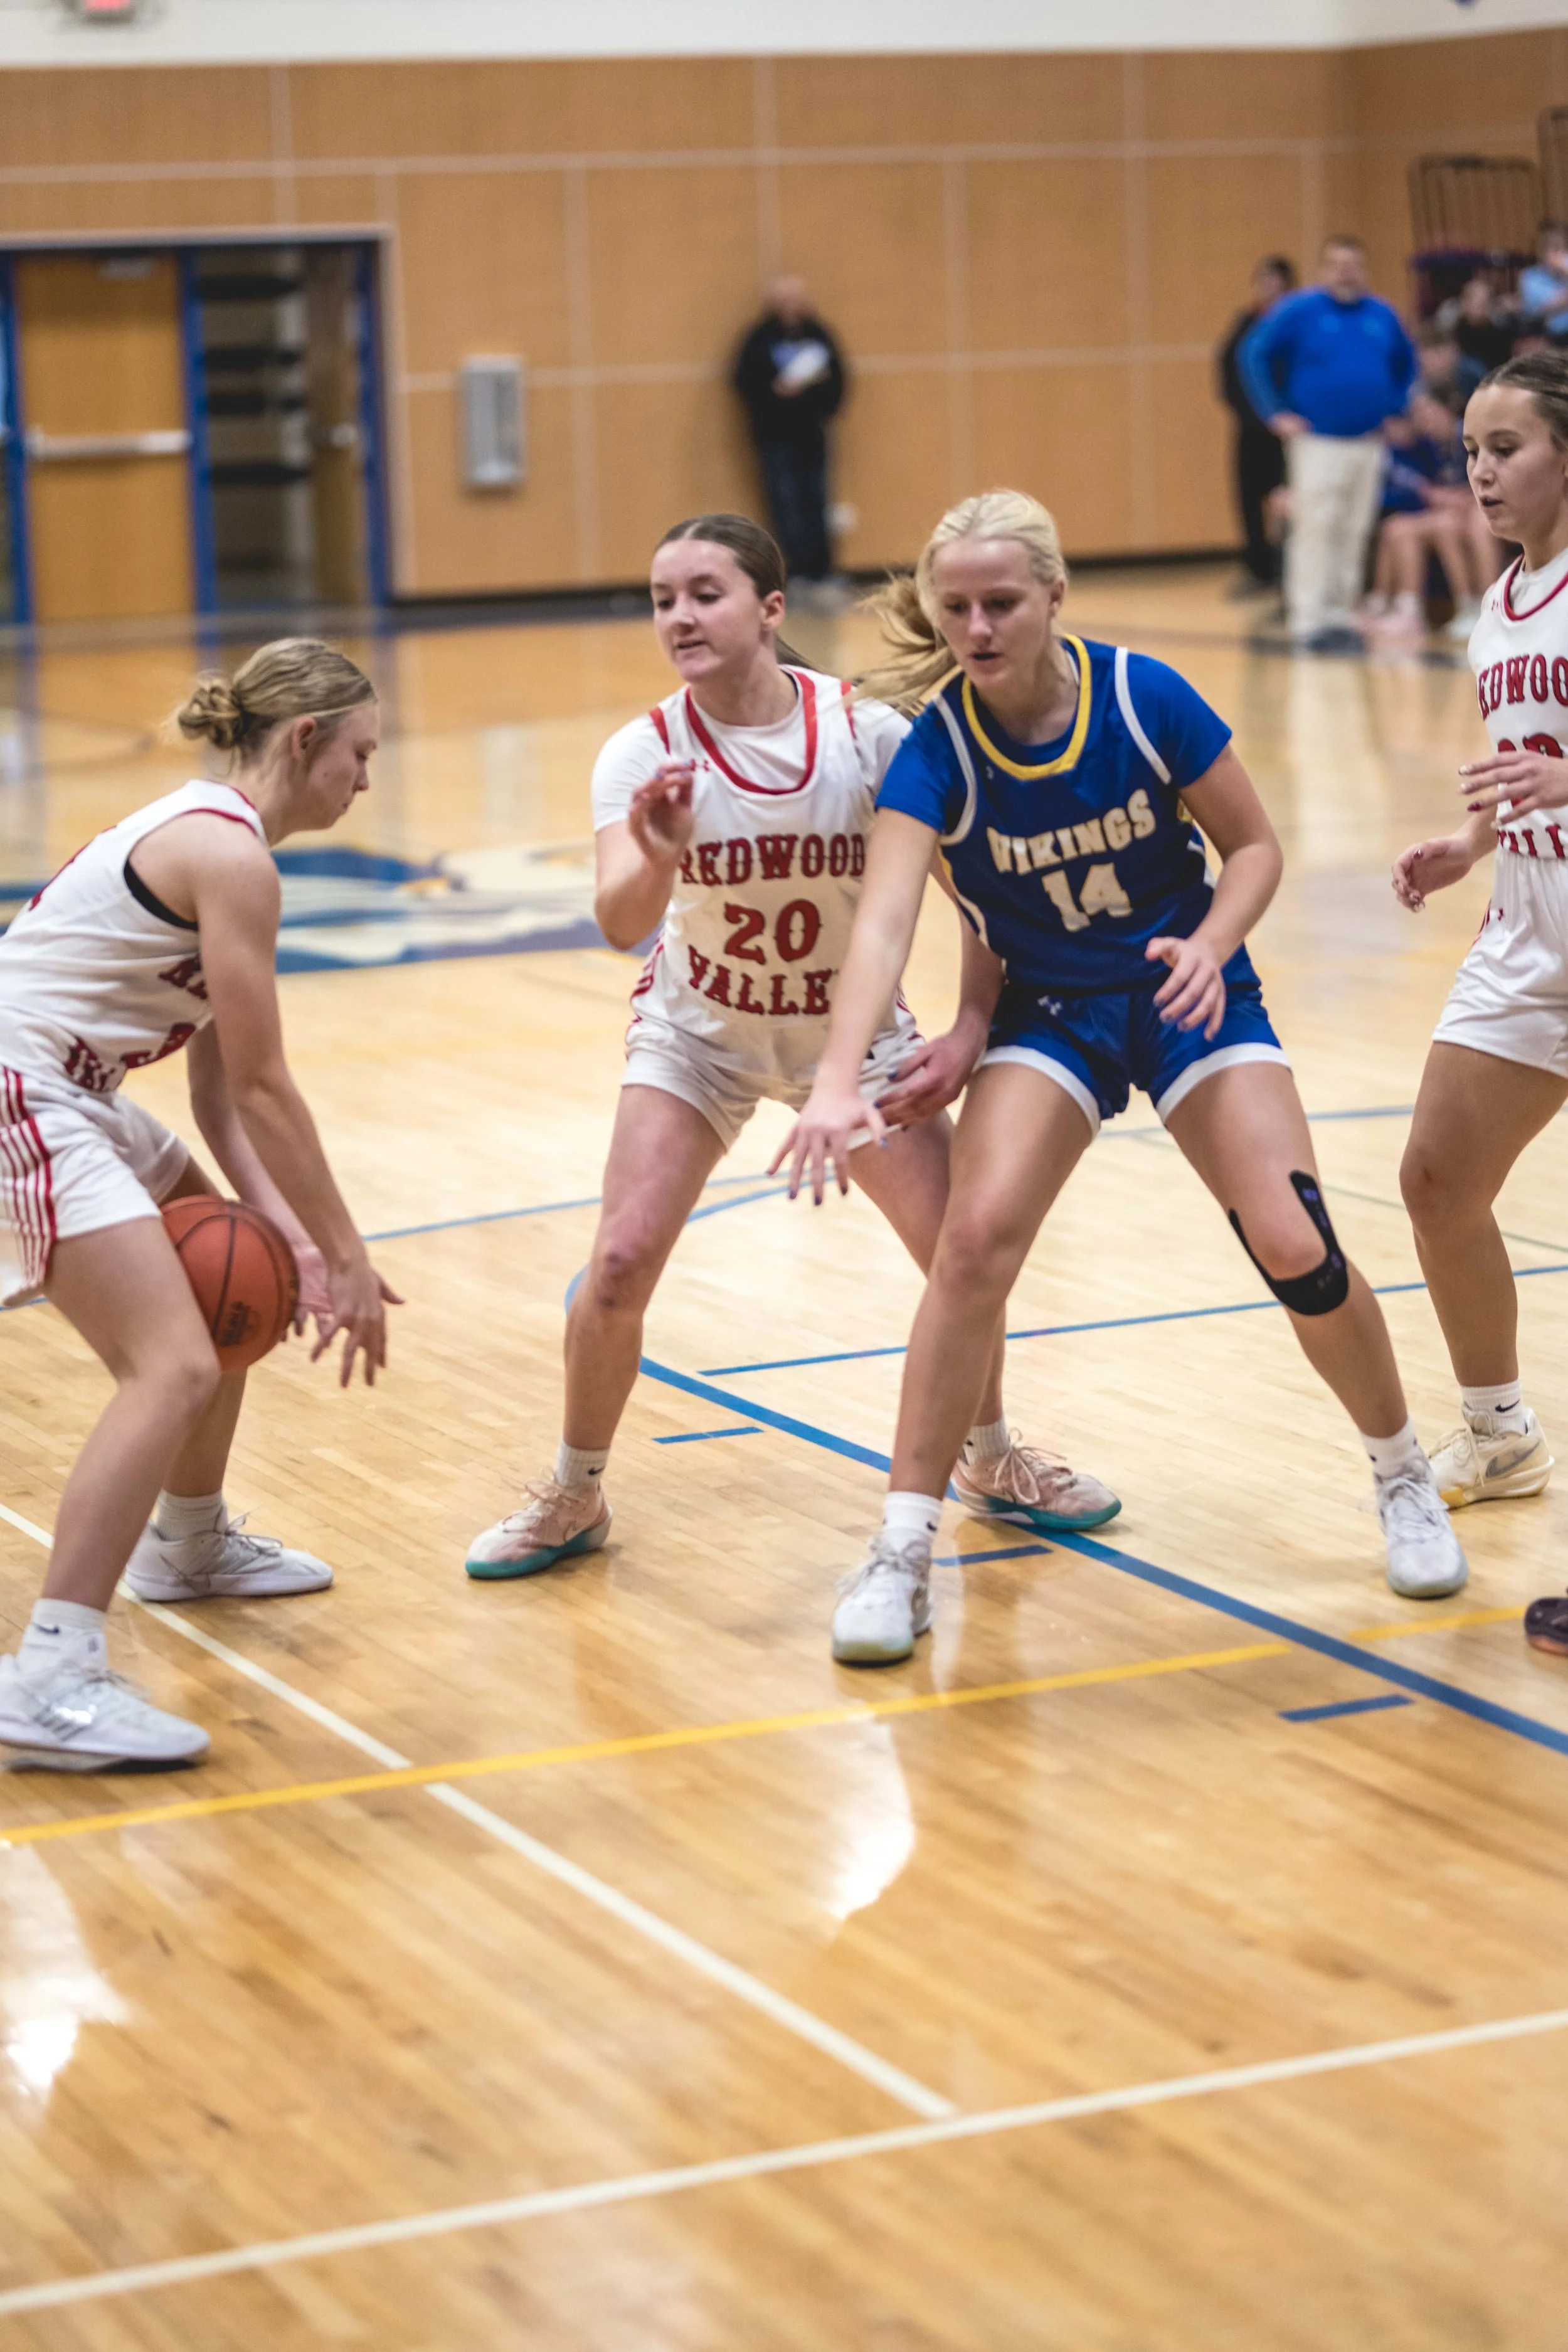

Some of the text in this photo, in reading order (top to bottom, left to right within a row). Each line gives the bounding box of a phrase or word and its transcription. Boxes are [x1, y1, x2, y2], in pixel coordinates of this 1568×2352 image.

[986, 788, 1157, 876] VIKINGS
[724, 898, 823, 965] 20
[1041, 862, 1133, 932] 14
[687, 944, 838, 1015] VALLE
